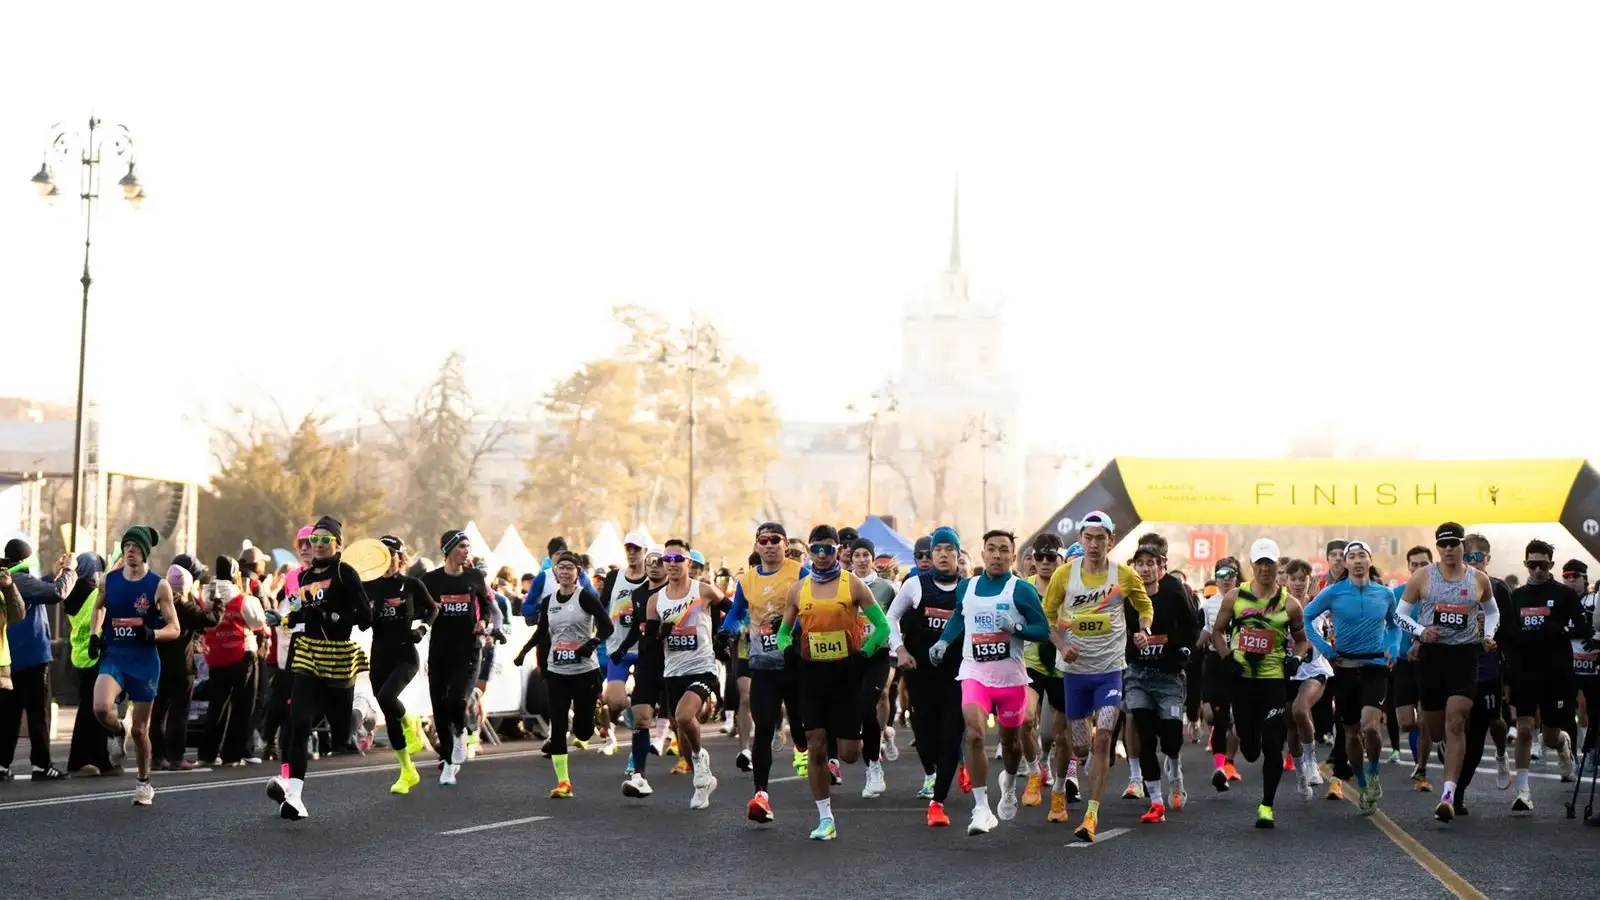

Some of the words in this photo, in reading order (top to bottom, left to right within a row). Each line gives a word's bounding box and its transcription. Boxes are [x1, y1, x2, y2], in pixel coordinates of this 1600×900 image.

[1254, 481, 1438, 506] FINISH
[1193, 539, 1211, 560] B
[1072, 583, 1114, 608] BMAI
[443, 602, 469, 613] 1482
[662, 596, 695, 621] BMAI
[1439, 612, 1464, 625] 865
[1524, 615, 1545, 626] 863
[1079, 620, 1104, 632] 887
[667, 635, 696, 646] 2583
[1242, 634, 1269, 649] 1218
[813, 641, 843, 654] 1841
[975, 642, 1007, 656] 1336
[556, 650, 576, 660] 798
